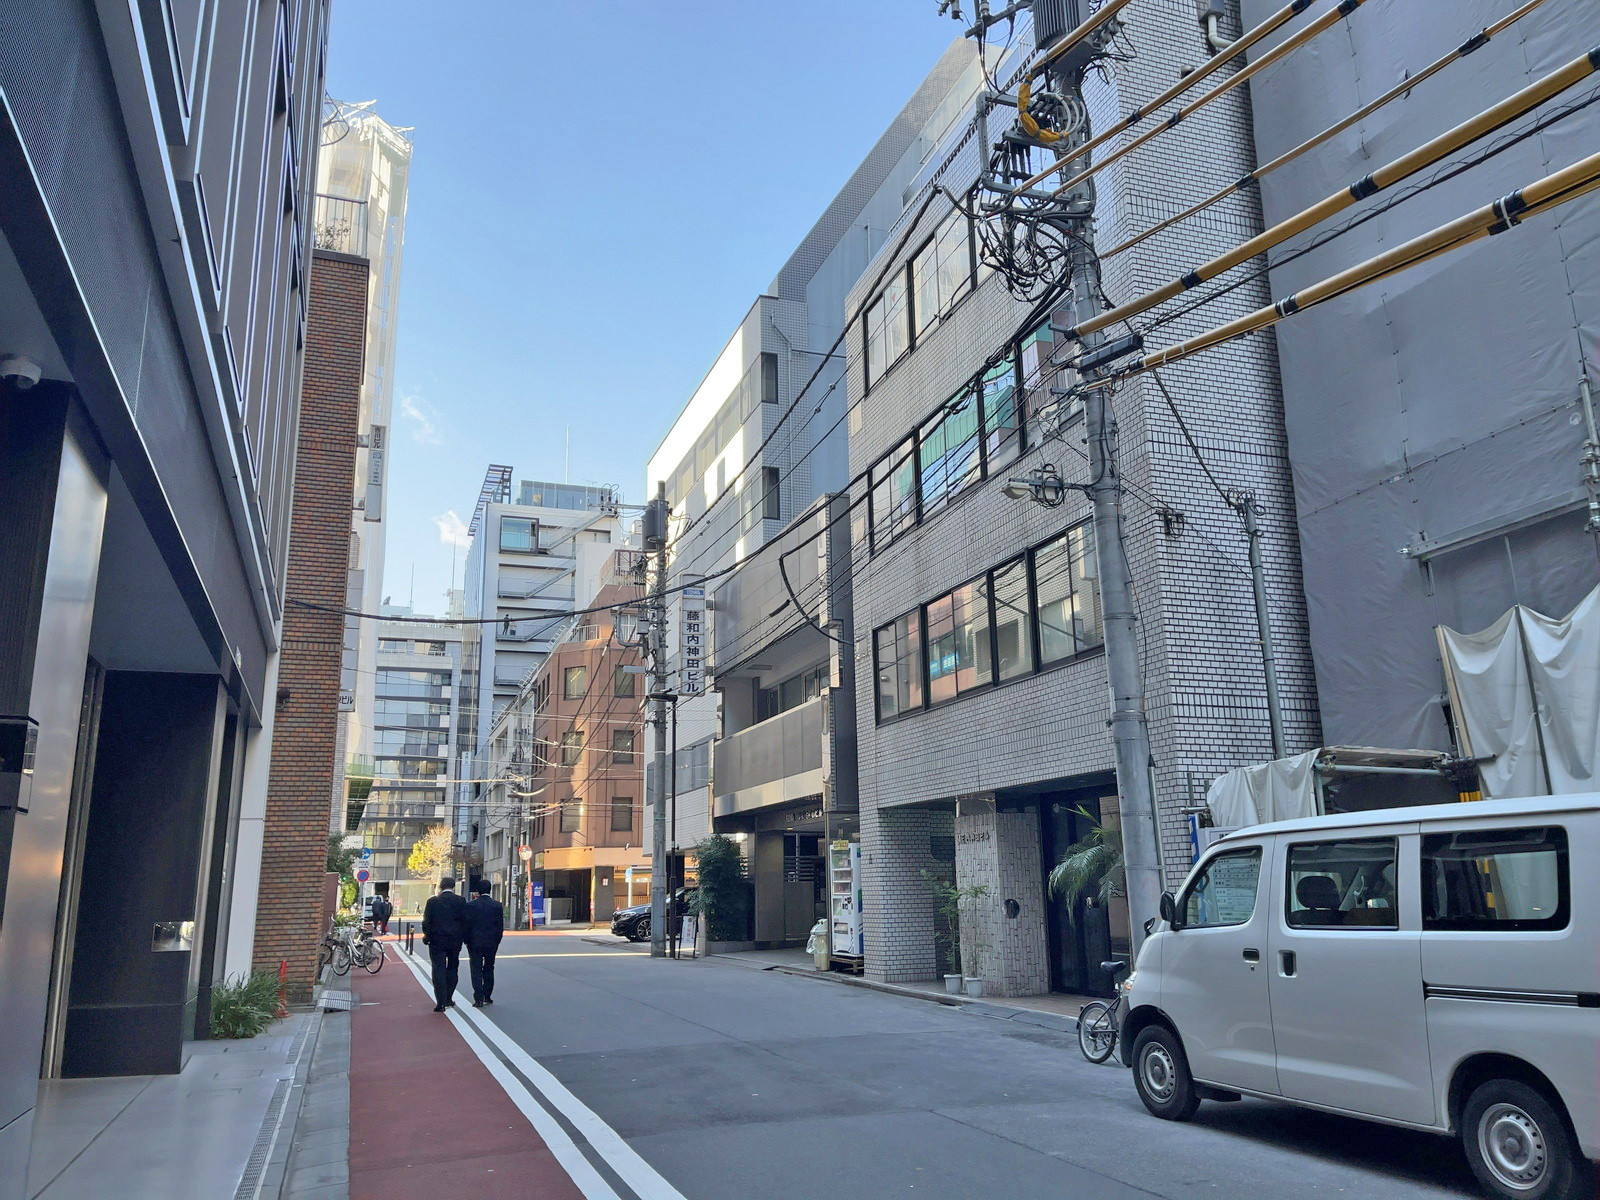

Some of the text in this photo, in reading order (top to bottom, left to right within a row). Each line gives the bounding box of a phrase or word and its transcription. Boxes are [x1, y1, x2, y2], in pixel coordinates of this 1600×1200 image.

[686, 611, 700, 693] 藤和内神田ビル
